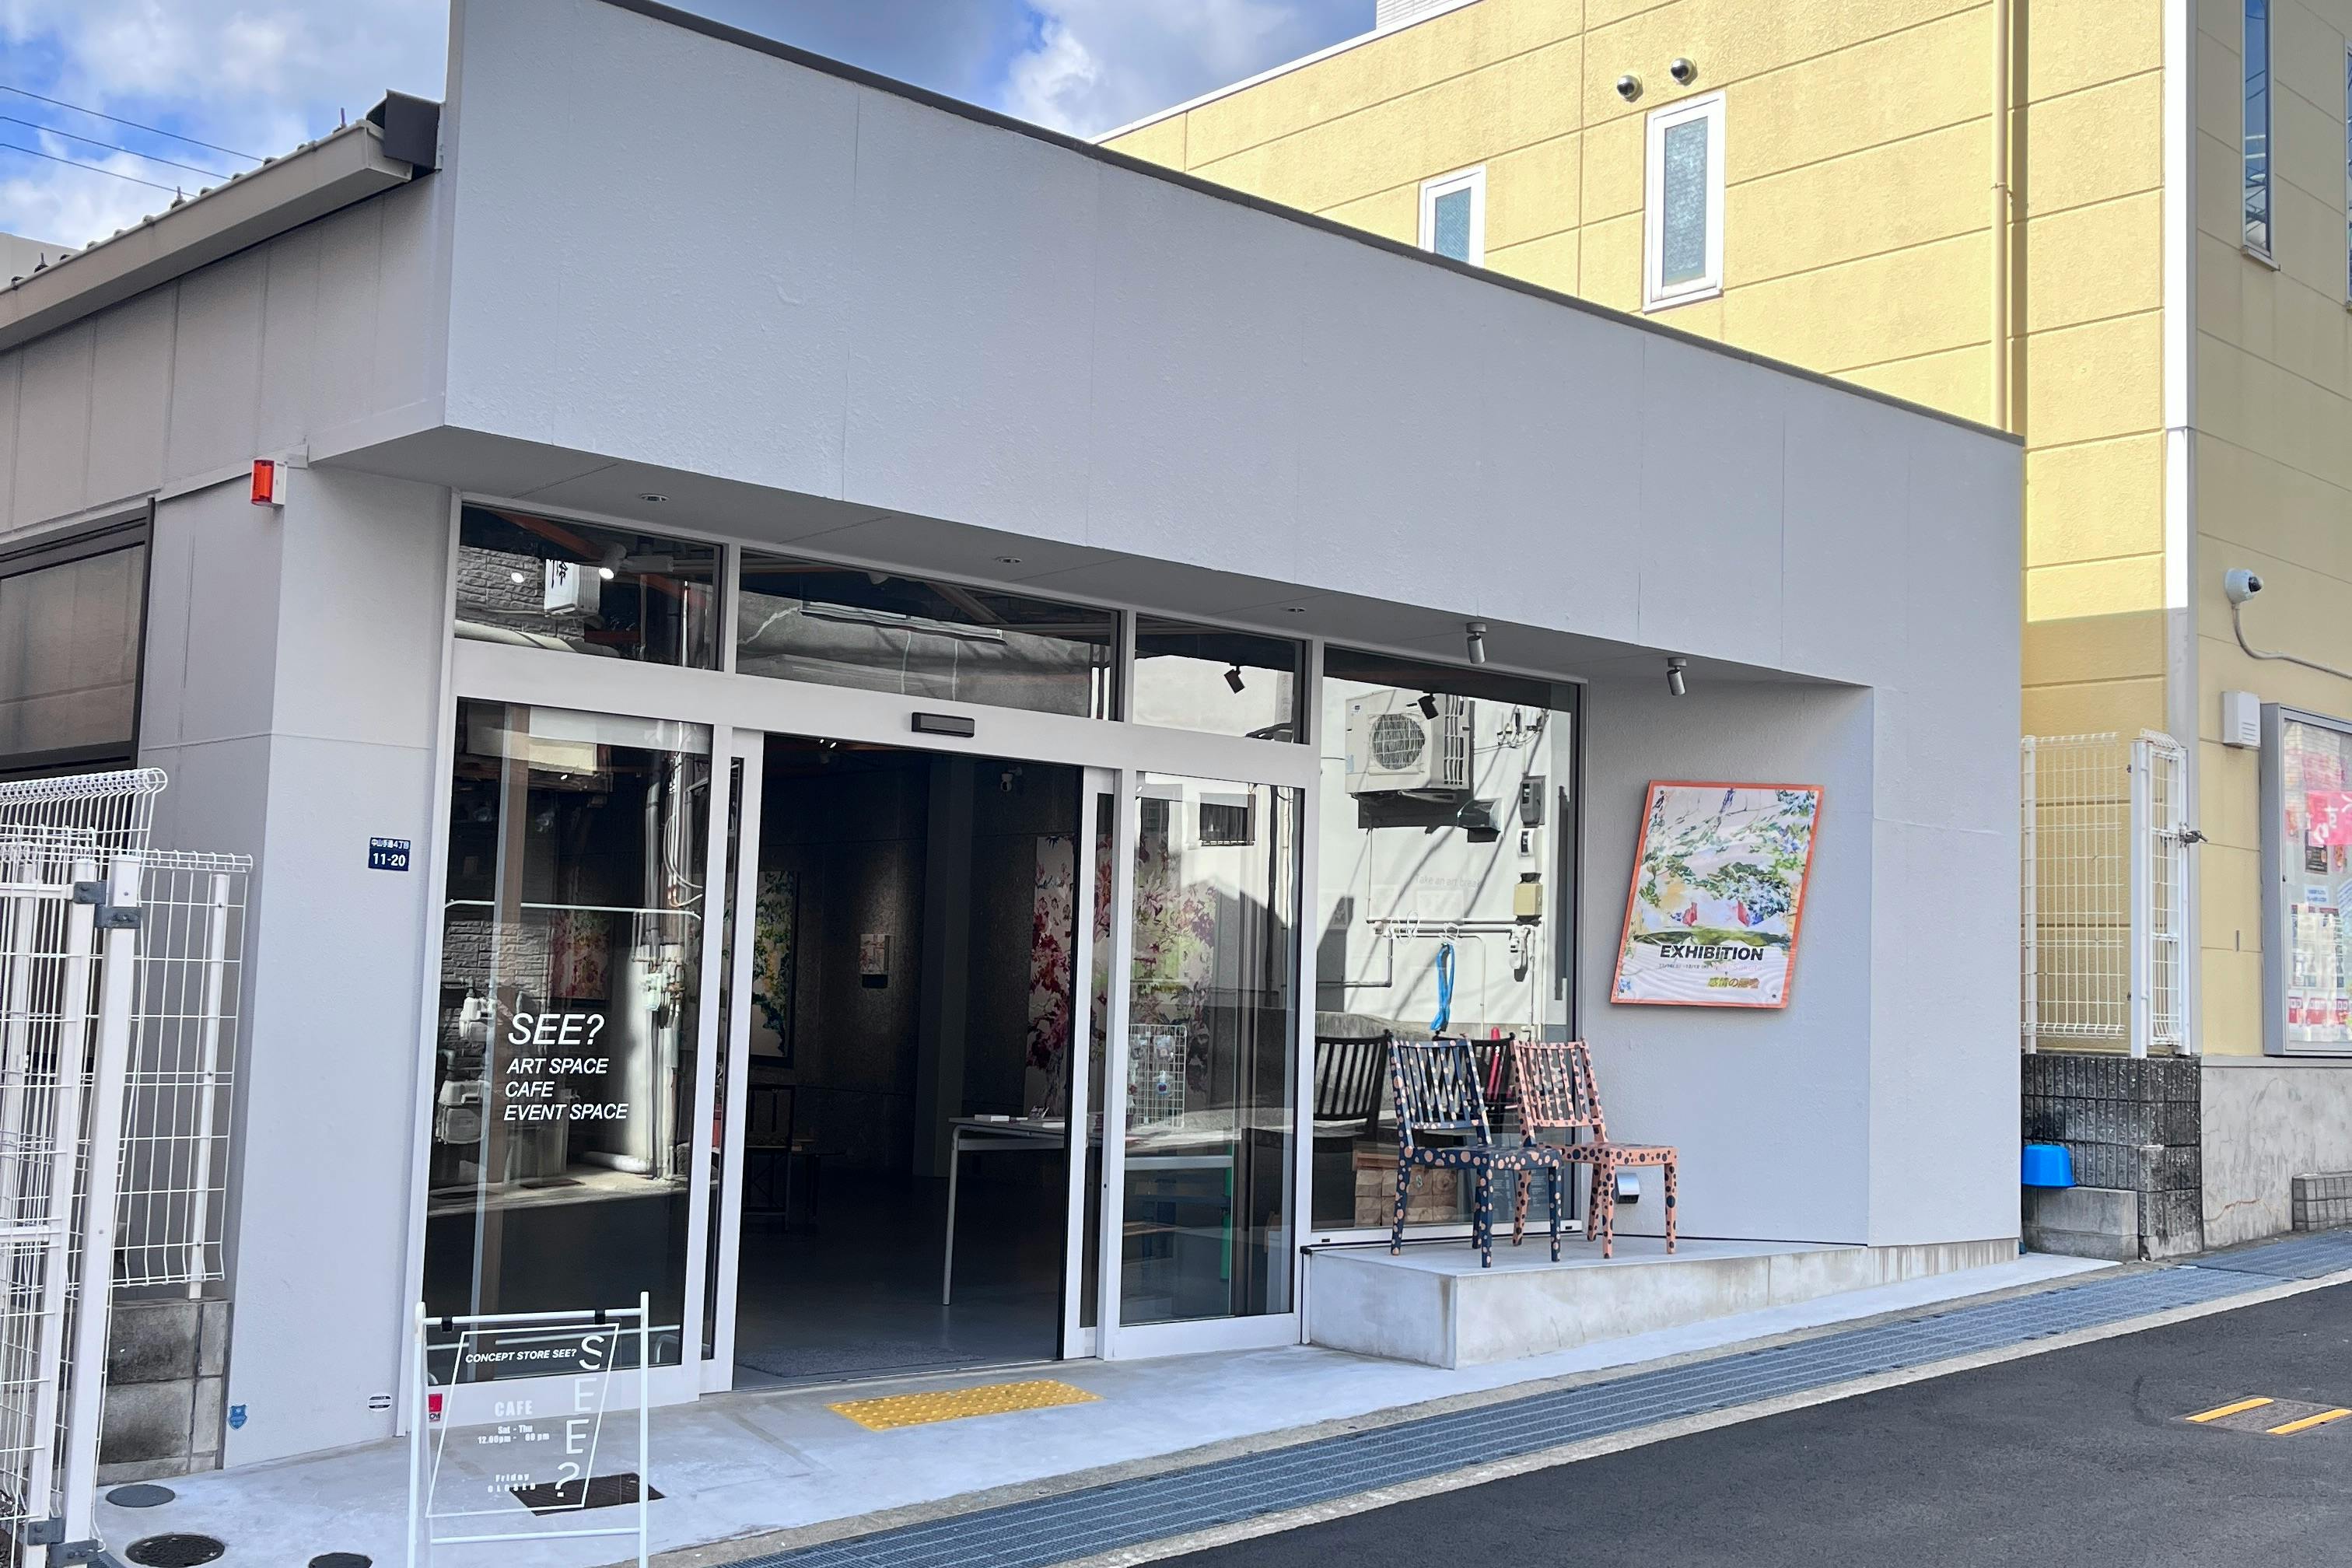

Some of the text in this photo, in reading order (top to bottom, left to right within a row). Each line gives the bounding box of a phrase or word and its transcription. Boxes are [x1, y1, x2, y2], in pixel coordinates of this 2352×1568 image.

[373, 852, 406, 867] 11-20
[1660, 945, 1764, 961] EXHIBITION
[508, 1013, 605, 1045] SEE?
[506, 1058, 609, 1074] ART SPACE
[505, 1081, 555, 1097] CAFE
[504, 1103, 628, 1121] EVENT SPACE
[465, 1349, 577, 1363] CONCEPT STORE SEE?
[495, 1400, 533, 1417] CAFE
[498, 1426, 510, 1434] Sat
[518, 1424, 533, 1433] Thu
[495, 1473, 529, 1482] Friday
[487, 1482, 536, 1493] CLOSED
